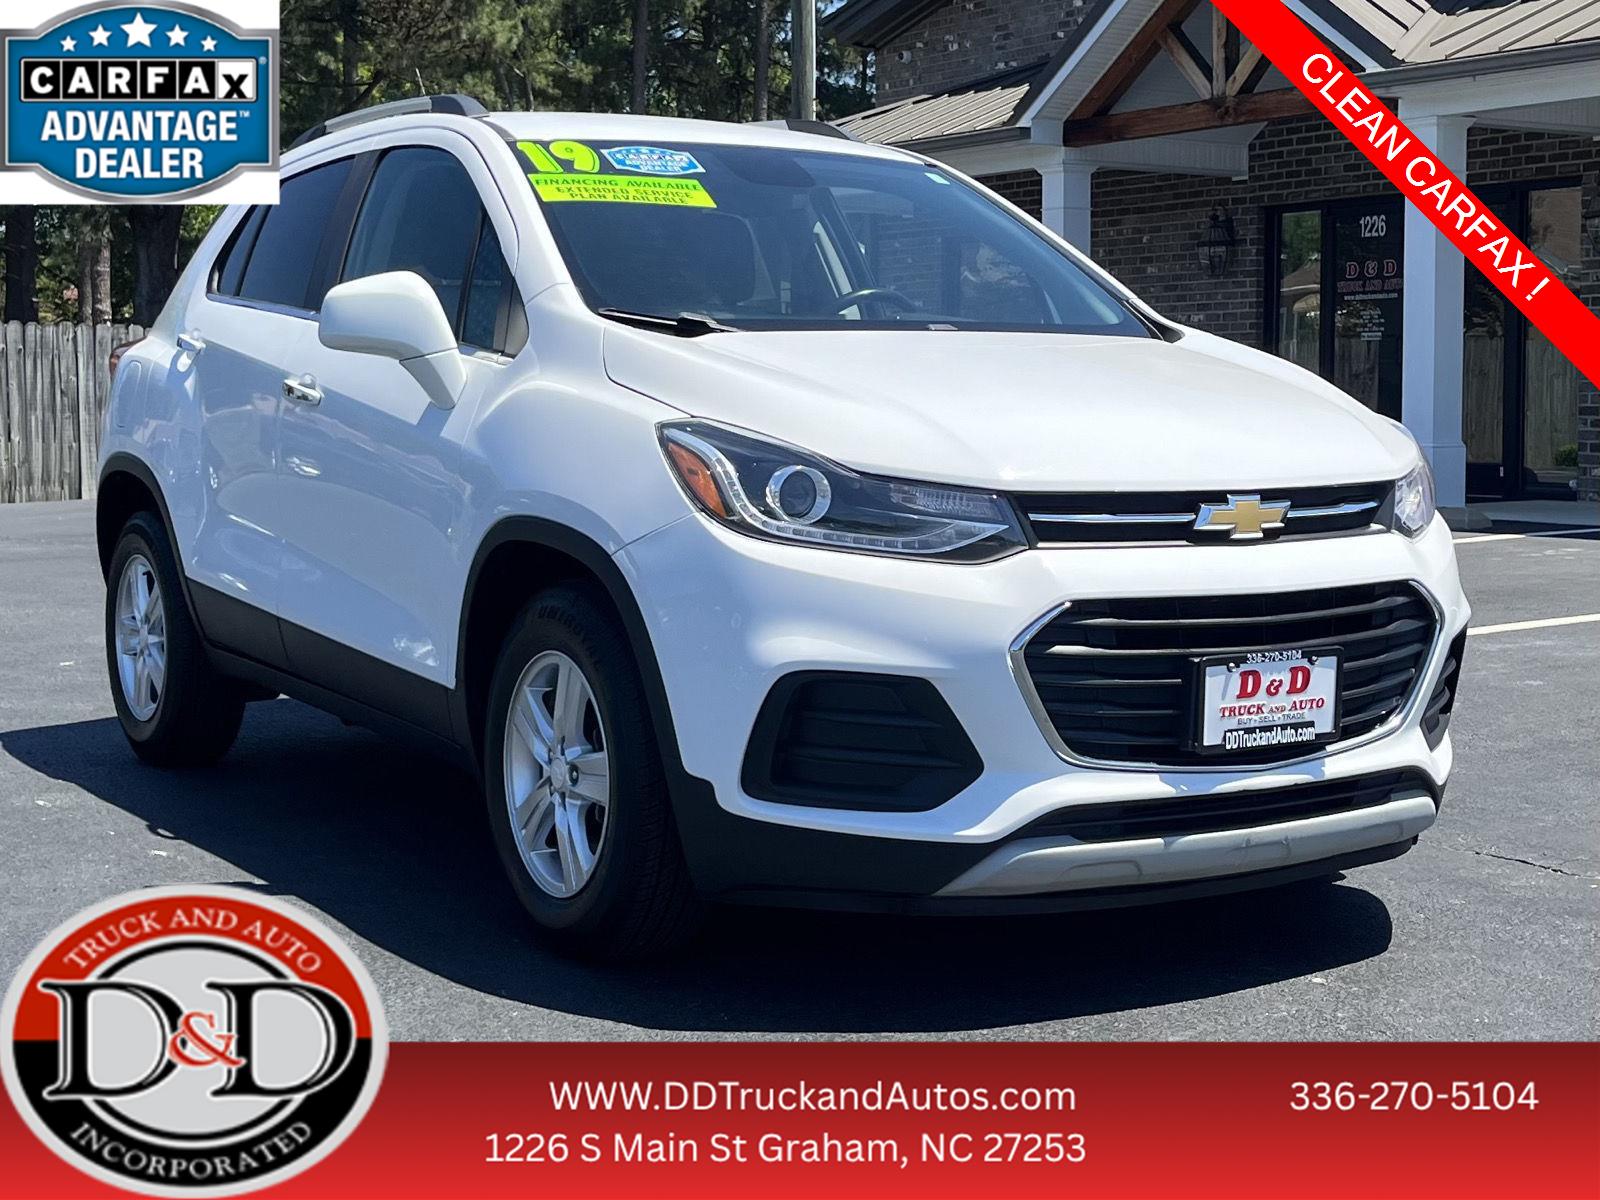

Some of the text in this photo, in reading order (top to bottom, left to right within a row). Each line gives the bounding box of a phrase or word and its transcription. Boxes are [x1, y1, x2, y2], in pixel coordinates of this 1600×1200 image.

[516, 141, 599, 173] 19
[535, 178, 701, 191] FINANCING AVAILABLE
[556, 186, 694, 199] EXTENDED SERVICE
[570, 192, 688, 204] PLAN AVAILABLE
[1360, 214, 1386, 238] 1226
[1345, 261, 1360, 278] D
[1383, 259, 1397, 276] D
[1246, 650, 1302, 664] 336-270-5104
[1219, 697, 1325, 719] TRUCK AND AUTO
[1237, 712, 1306, 726] BUY SELL TRADE
[1225, 726, 1316, 749] DDTruckandAuto.com
